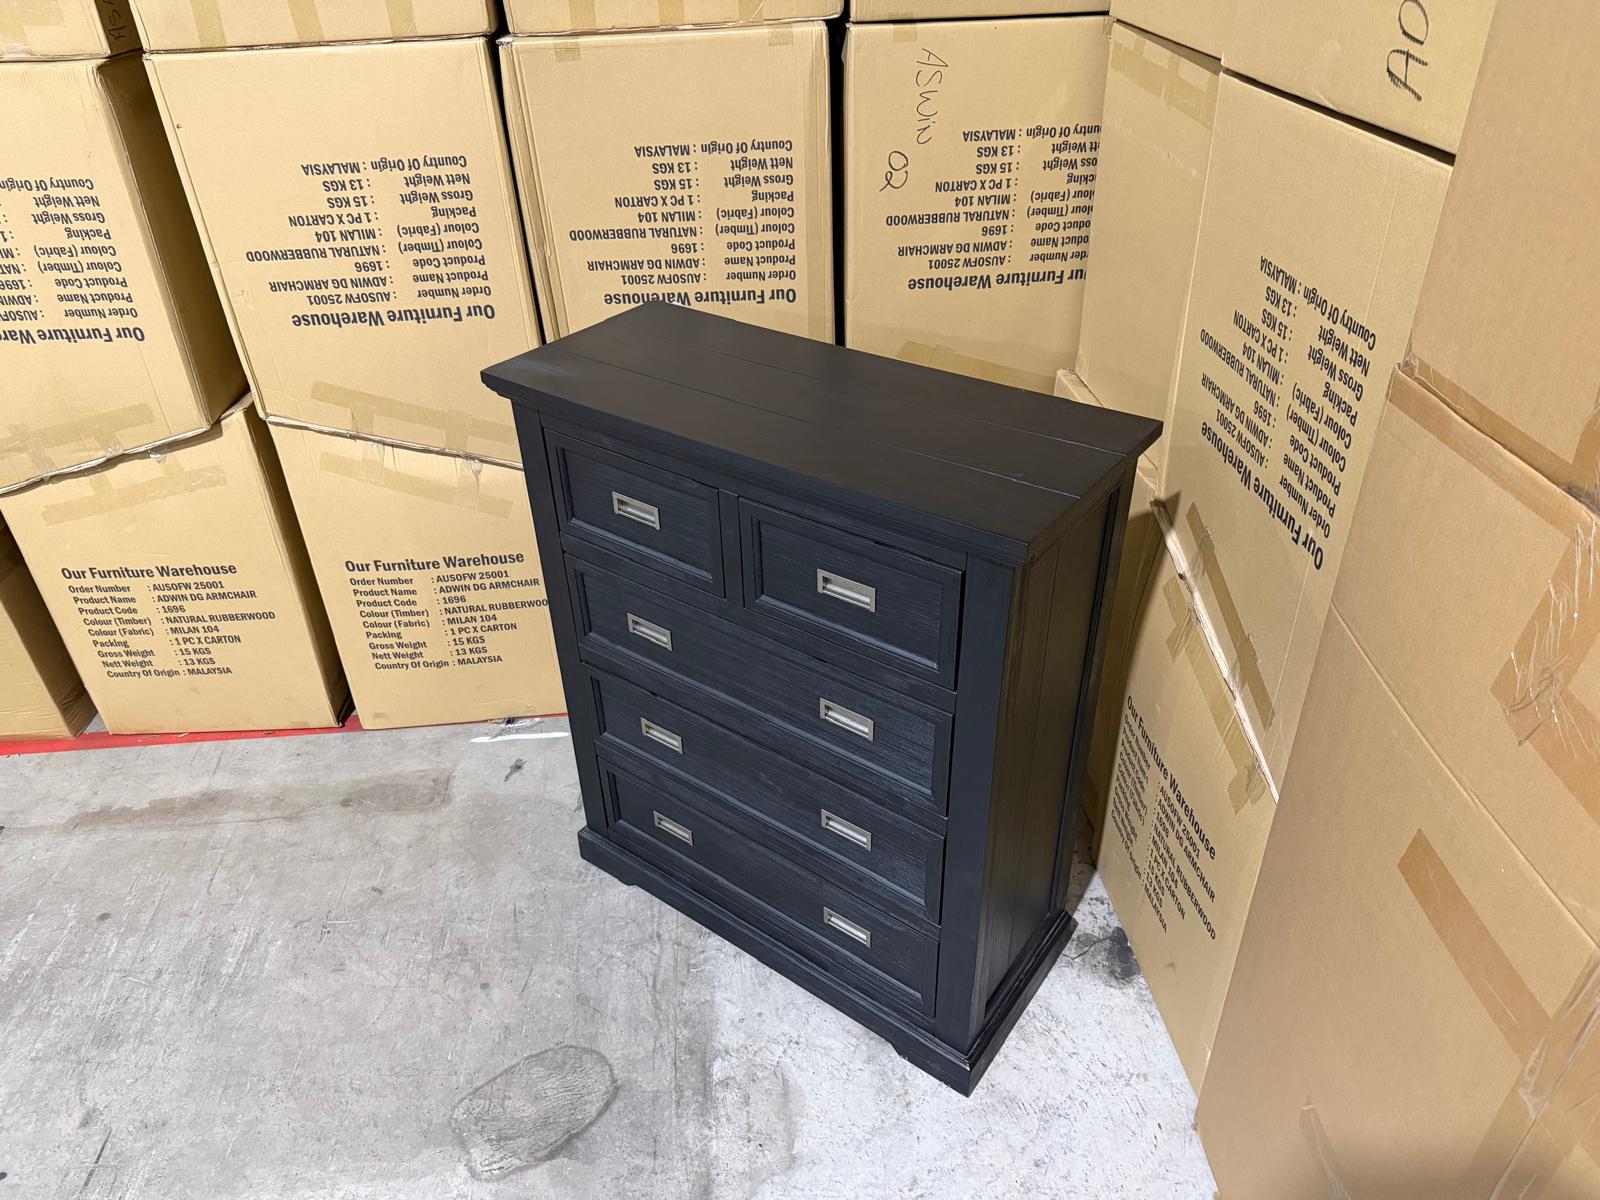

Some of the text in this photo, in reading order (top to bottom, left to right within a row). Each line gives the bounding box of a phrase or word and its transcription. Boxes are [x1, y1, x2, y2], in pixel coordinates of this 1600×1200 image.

[1026, 124, 1057, 139] Origin
[1058, 126, 1071, 139] Of
[1073, 122, 1103, 137] untry
[300, 154, 467, 176] Country Of Origin MALAYSIA
[0, 176, 95, 192] Country Of Origin
[32, 194, 101, 208] Nett Weight
[614, 196, 658, 208] CARTON
[660, 195, 668, 207] X
[670, 194, 685, 207] PC
[751, 189, 794, 203] Packing
[30, 210, 106, 225] Gross Weight
[637, 206, 795, 224] Colour (Fabric) MILAN 104
[1027, 203, 1069, 219] (Timber)
[885, 212, 961, 226] RUBBERWOOD
[64, 227, 112, 241] Packing
[570, 221, 795, 241] Colour (Timber) NATURAL RUBBERWOOD
[670, 239, 796, 254] Product Code 1696
[955, 242, 971, 254] DG
[1030, 237, 1059, 248] Name
[1061, 235, 1091, 247] oduct
[33, 244, 117, 259] Colour (Fabric)
[246, 238, 483, 262] Colour (Timber) NATURAL RUBBERWOOD
[897, 243, 954, 257] ARMCHAIR
[36, 259, 85, 274] (Timber)
[86, 260, 123, 273] Colour
[54, 278, 84, 289] Code
[83, 276, 129, 289] Product
[268, 270, 489, 293] Product Name ADWIN DG ARMCHAIR
[907, 268, 1087, 292] ur Furniture Warehouse
[56, 293, 90, 305] Name
[88, 292, 134, 304] Product
[306, 285, 492, 306] Order Number AUSOFW 25001
[694, 289, 766, 306] Furniture
[768, 288, 797, 303] Our
[1265, 285, 1282, 310] KGS
[63, 308, 107, 320] Number
[107, 307, 139, 318] Order
[291, 304, 496, 328] Our Furniture Warehouse
[1261, 308, 1278, 332] KGS
[35, 327, 115, 344] Furniture
[116, 326, 146, 342] Our
[1318, 325, 1349, 362] Weight
[1242, 341, 1257, 364] 104
[1307, 345, 1337, 382] Weight
[1349, 348, 1371, 377] Nett
[1338, 368, 1364, 401] Gross
[1292, 383, 1324, 424] (Fabric)
[1216, 408, 1237, 439] 25001
[1323, 414, 1352, 449] Colour
[1201, 421, 1324, 570] Our Furniture Warehouse
[1279, 475, 1309, 515] Number
[1308, 506, 1331, 539] Order
[344, 553, 524, 573] Our Furniture Warehouse
[61, 563, 237, 580] Our Furniture Warehouse
[68, 585, 94, 594] Order
[94, 584, 131, 593] Number
[193, 581, 225, 590] 25001
[72, 595, 110, 605] Product
[109, 595, 137, 604] Name
[189, 593, 205, 601] DG
[206, 590, 257, 600] ARMCHAIR
[355, 598, 393, 608] Product
[393, 598, 418, 607] Code
[359, 610, 390, 619] Colour
[390, 608, 430, 620] (Timber)
[488, 599, 549, 611] RUBBERWOO
[82, 618, 113, 627] Colour
[113, 616, 152, 628] (Timber)
[208, 612, 276, 622] RUBBERWOOD
[365, 630, 403, 640] Packing
[457, 626, 471, 635] PC
[471, 625, 479, 634] X
[480, 623, 518, 632] CARTON
[97, 650, 124, 658] Gross
[122, 649, 156, 659] Weight
[192, 647, 212, 656] KGS
[374, 661, 409, 671] Country
[410, 660, 421, 669] Of
[422, 659, 450, 669] Origin
